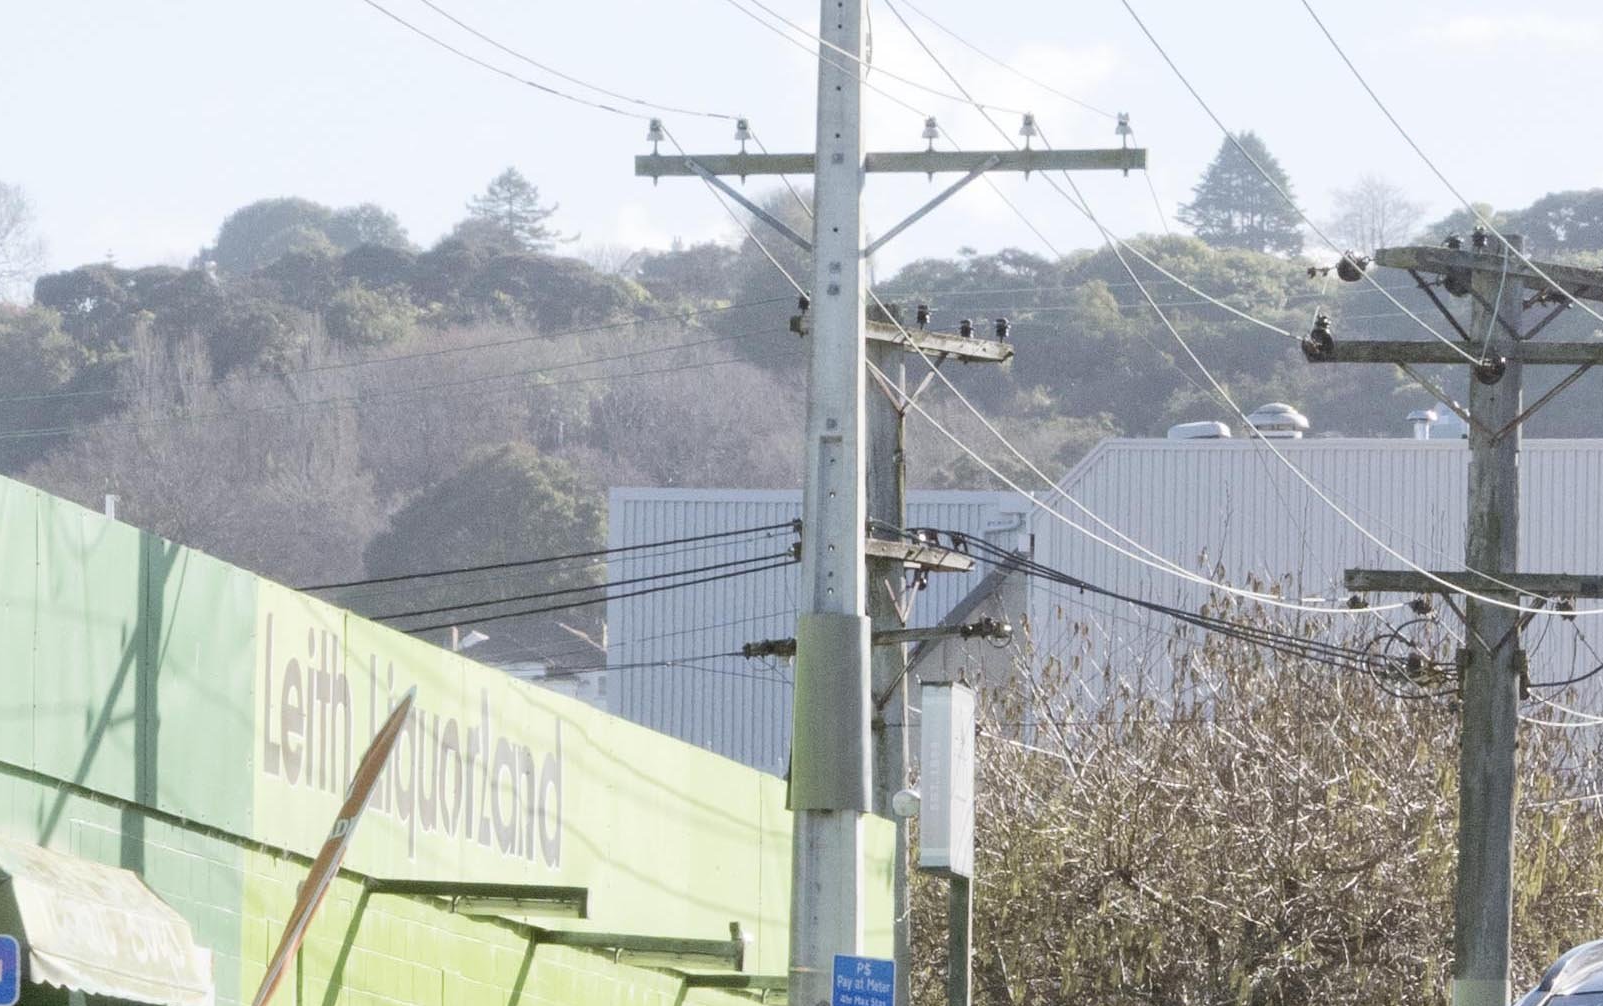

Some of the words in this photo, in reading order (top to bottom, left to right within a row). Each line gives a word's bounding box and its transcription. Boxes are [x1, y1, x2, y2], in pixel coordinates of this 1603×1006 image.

[263, 612, 353, 794] Leith
[837, 974, 853, 992] Pay
[855, 978, 864, 990] at
[866, 978, 891, 993] Meter
